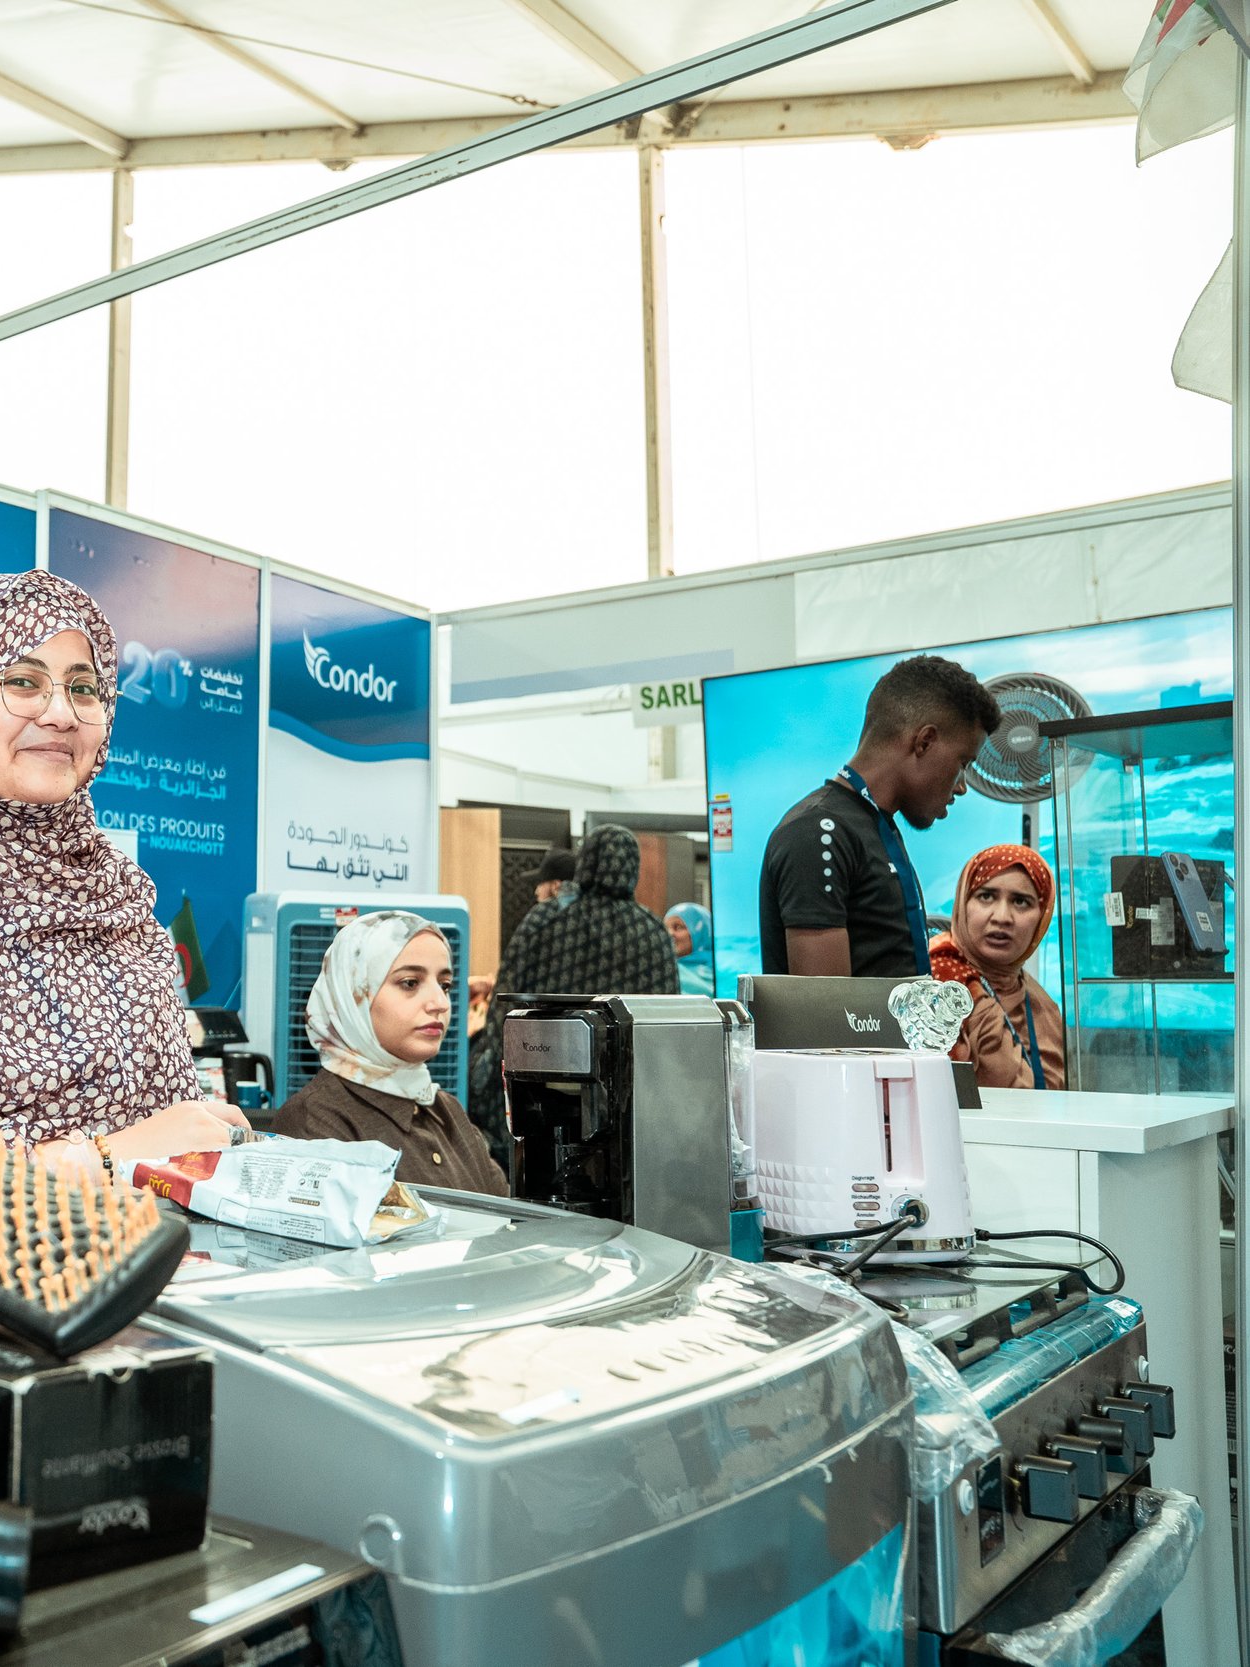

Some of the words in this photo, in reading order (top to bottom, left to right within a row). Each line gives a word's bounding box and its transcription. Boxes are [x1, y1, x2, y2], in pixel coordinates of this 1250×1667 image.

[200, 666, 243, 686] تخفيضات
[315, 655, 398, 703] Condor
[640, 682, 703, 711] SARL
[141, 751, 181, 773] معرض
[184, 759, 206, 780] إطار
[207, 765, 227, 783] في
[159, 773, 226, 801] الجزائرية
[129, 812, 157, 833] DES
[160, 817, 225, 841] PRODUITS
[287, 820, 347, 847] الجودة
[149, 835, 225, 857] NOUAKCHOTT
[350, 832, 408, 855] كوندور
[287, 850, 340, 878] بها
[343, 855, 370, 879] تثق
[373, 863, 408, 888] التي
[852, 1014, 881, 1032] Condor
[524, 1043, 551, 1052] Condor
